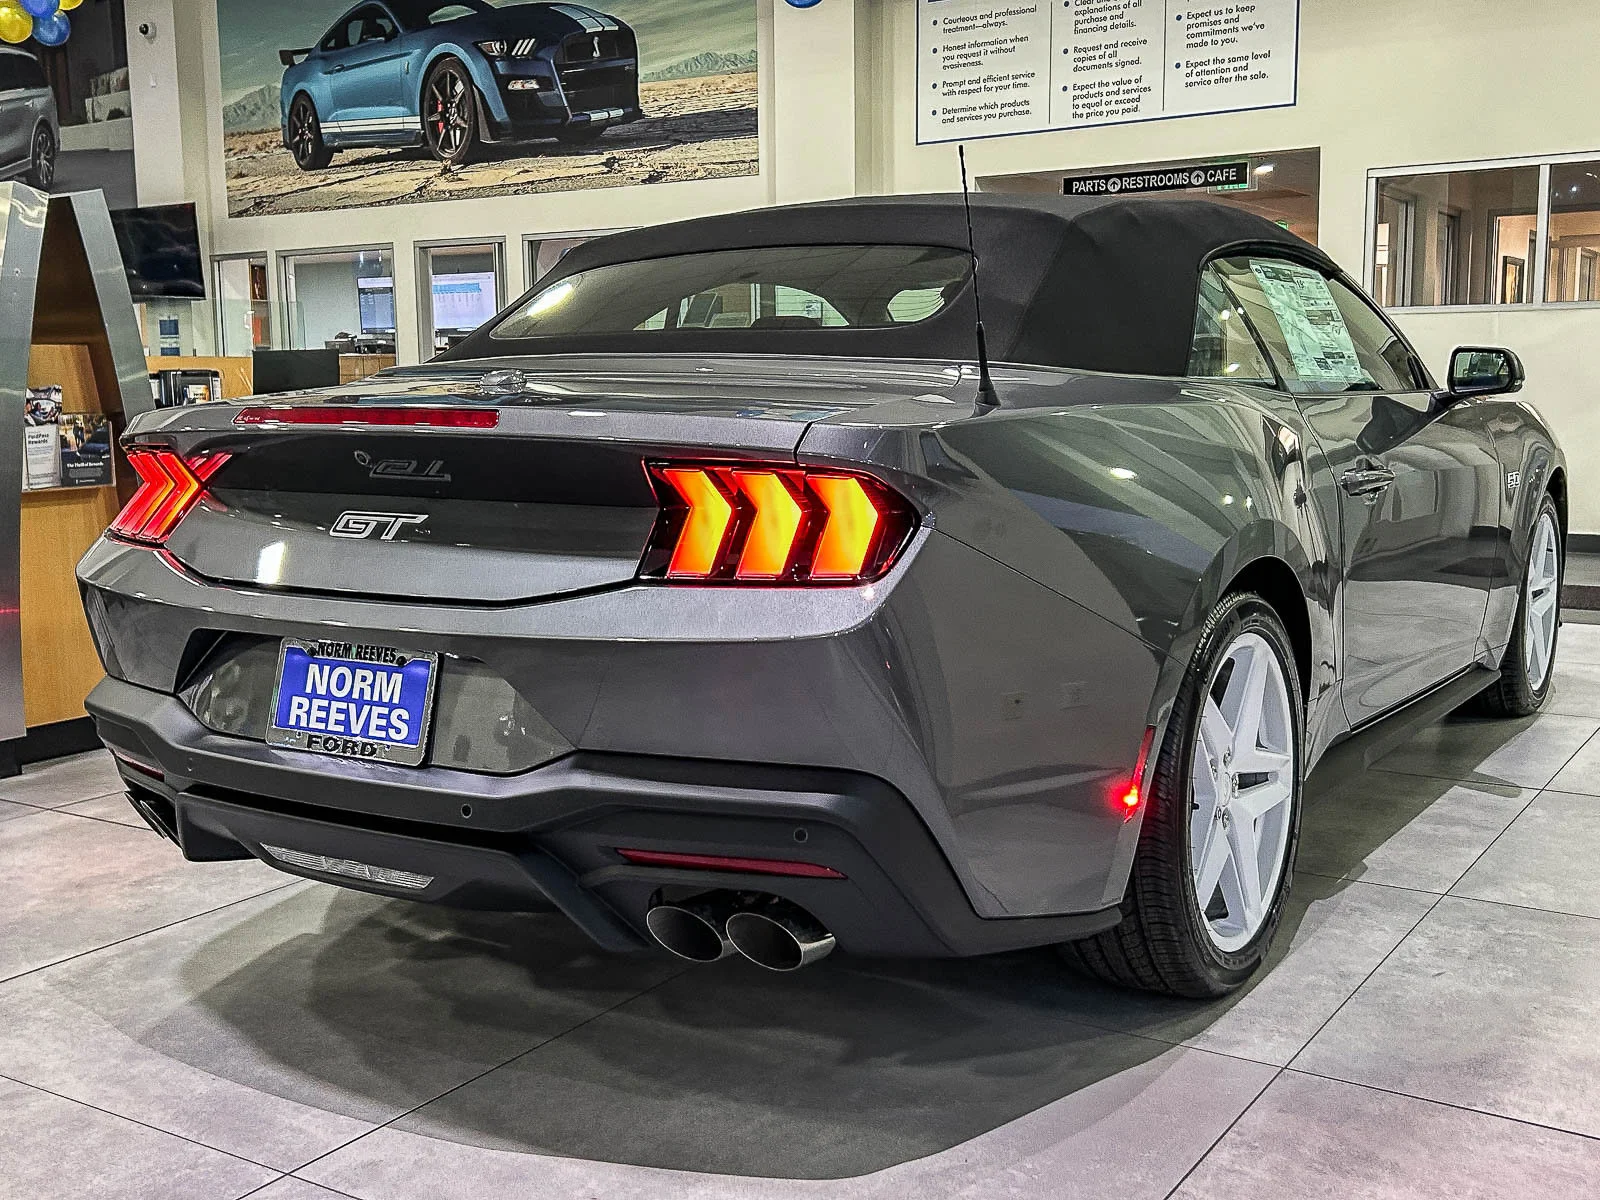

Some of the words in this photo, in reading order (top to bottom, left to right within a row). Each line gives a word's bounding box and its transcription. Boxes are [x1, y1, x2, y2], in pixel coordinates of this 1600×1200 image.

[943, 15, 978, 25] Courteous
[979, 11, 993, 19] and
[994, 4, 1037, 19] professional
[1074, 3, 1121, 16] explanations
[1122, 1, 1131, 9] of
[1132, 0, 1142, 8] all
[1186, 9, 1212, 20] Expect
[1235, 4, 1256, 13] keep
[1074, 15, 1108, 26] purchase
[1109, 11, 1124, 20] and
[1186, 18, 1222, 31] promises
[1223, 15, 1240, 24] and
[1074, 24, 1108, 34] financing
[1109, 20, 1137, 30] details.
[1186, 26, 1239, 39] commitments
[943, 43, 967, 52] Honest
[968, 37, 1008, 49] information
[1009, 35, 1029, 43] when
[1073, 43, 1102, 54] Request
[1103, 41, 1119, 50] and
[1120, 38, 1148, 48] receive
[1186, 39, 1209, 49] made
[1220, 37, 1238, 46] you.
[942, 54, 955, 63] you
[956, 50, 982, 60] request
[983, 48, 988, 56] it
[989, 46, 1016, 55] without
[1073, 54, 1097, 63] copies
[1098, 51, 1107, 59] of
[1107, 50, 1118, 59] all
[1185, 58, 1211, 69] Expect
[1212, 56, 1226, 65] the
[1227, 55, 1249, 63] same
[1251, 50, 1271, 60] level
[1073, 61, 1113, 72] documents
[1114, 56, 1142, 68] signed.
[1185, 69, 1194, 78] of
[1195, 66, 1231, 77] attention
[1232, 63, 1249, 72] and
[942, 80, 966, 88] Prompt
[967, 76, 981, 85] and
[982, 73, 1010, 84] efficient
[1011, 71, 1036, 80] service
[1072, 82, 1096, 91] Expect
[1097, 80, 1110, 88] the
[1111, 77, 1132, 86] value
[1134, 75, 1143, 83] of
[1184, 78, 1212, 88] service
[1213, 75, 1233, 85] after
[1234, 73, 1248, 82] the
[1249, 71, 1269, 80] sale.
[942, 89, 956, 97] with
[957, 86, 982, 96] respect
[983, 84, 993, 92] for
[994, 84, 1011, 93] your
[1012, 81, 1030, 89] time.
[1072, 91, 1104, 102] products
[1105, 88, 1120, 97] and
[1122, 86, 1152, 95] services
[942, 104, 977, 115] Determine
[978, 101, 999, 111] which
[1000, 99, 1030, 110] products
[1081, 99, 1103, 110] equal
[1114, 95, 1141, 105] exceed
[941, 115, 955, 124] and
[956, 113, 982, 122] services
[983, 112, 997, 120] you
[998, 108, 1032, 119] purchase.
[1072, 111, 1084, 119] the
[1085, 109, 1104, 119] price
[1105, 109, 1120, 117] you
[1072, 179, 1106, 193] PARTS
[1122, 172, 1190, 190] RESTROOMS
[1206, 168, 1237, 182] CAFE
[329, 510, 429, 540] GT
[318, 642, 353, 657] NORM
[354, 645, 398, 663] REEVES
[304, 663, 403, 704] NORM
[288, 695, 410, 741] REEVES
[307, 734, 377, 757] FORD
